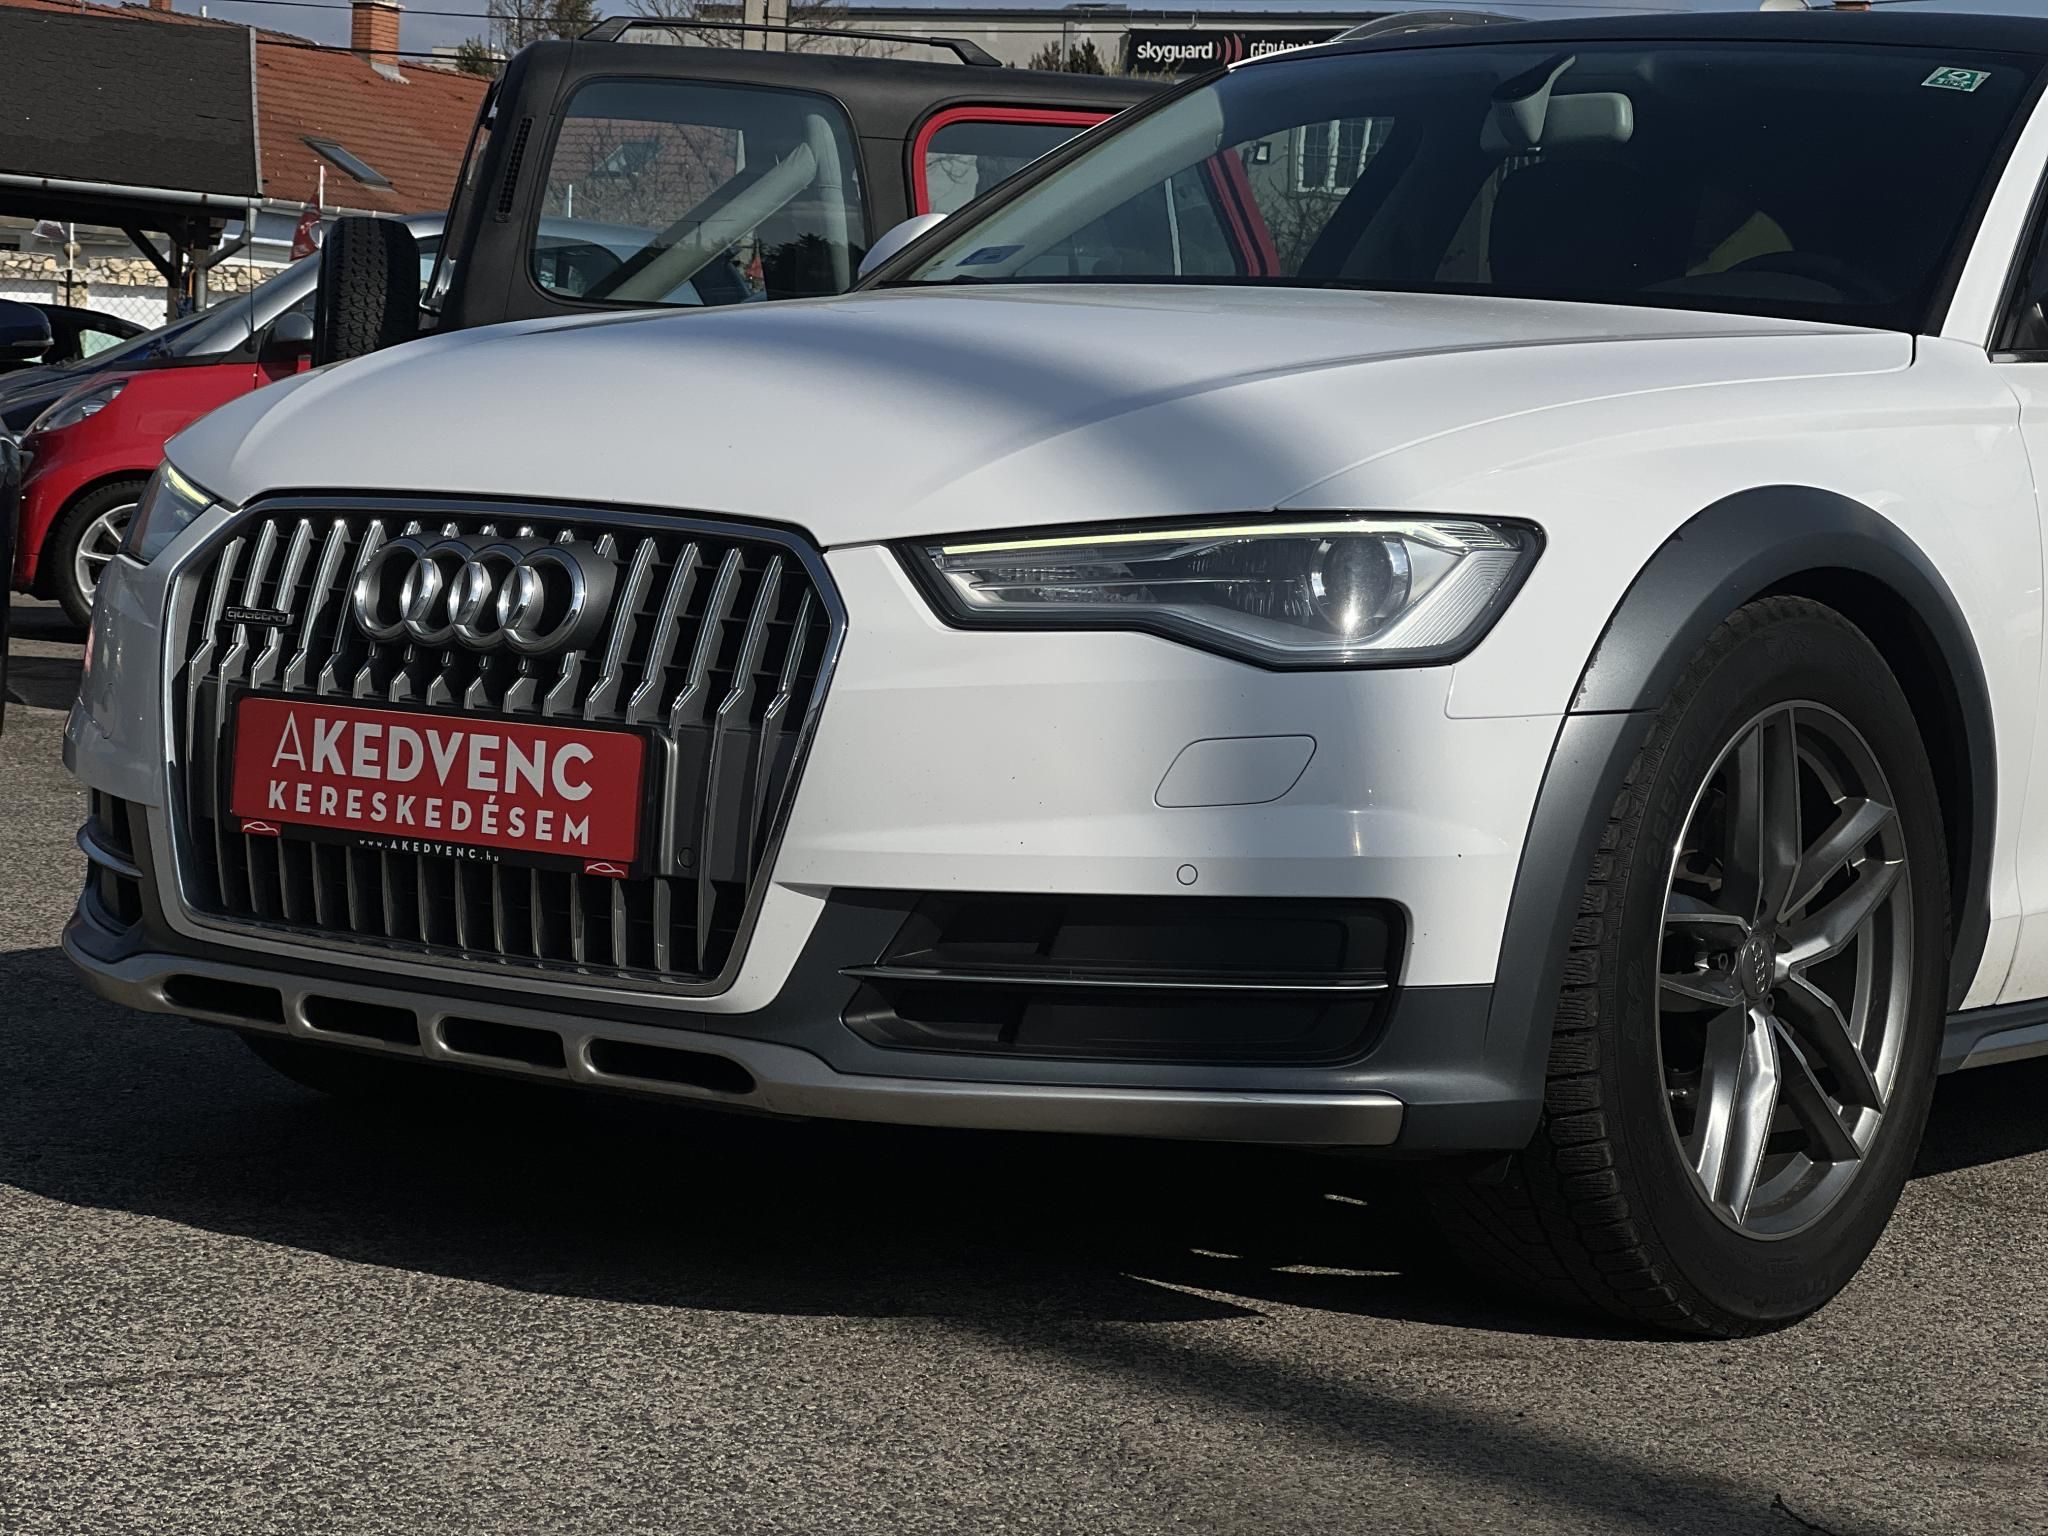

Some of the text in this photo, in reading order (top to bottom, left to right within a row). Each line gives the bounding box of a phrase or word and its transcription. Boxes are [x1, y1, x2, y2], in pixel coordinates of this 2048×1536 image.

[1137, 41, 1213, 63] skyguard
[227, 610, 286, 623] quattro
[271, 710, 594, 801] AKEDVENC
[268, 780, 590, 845] KERESKEDÉSEM
[359, 839, 499, 862] www.AKEDVENC.hu
